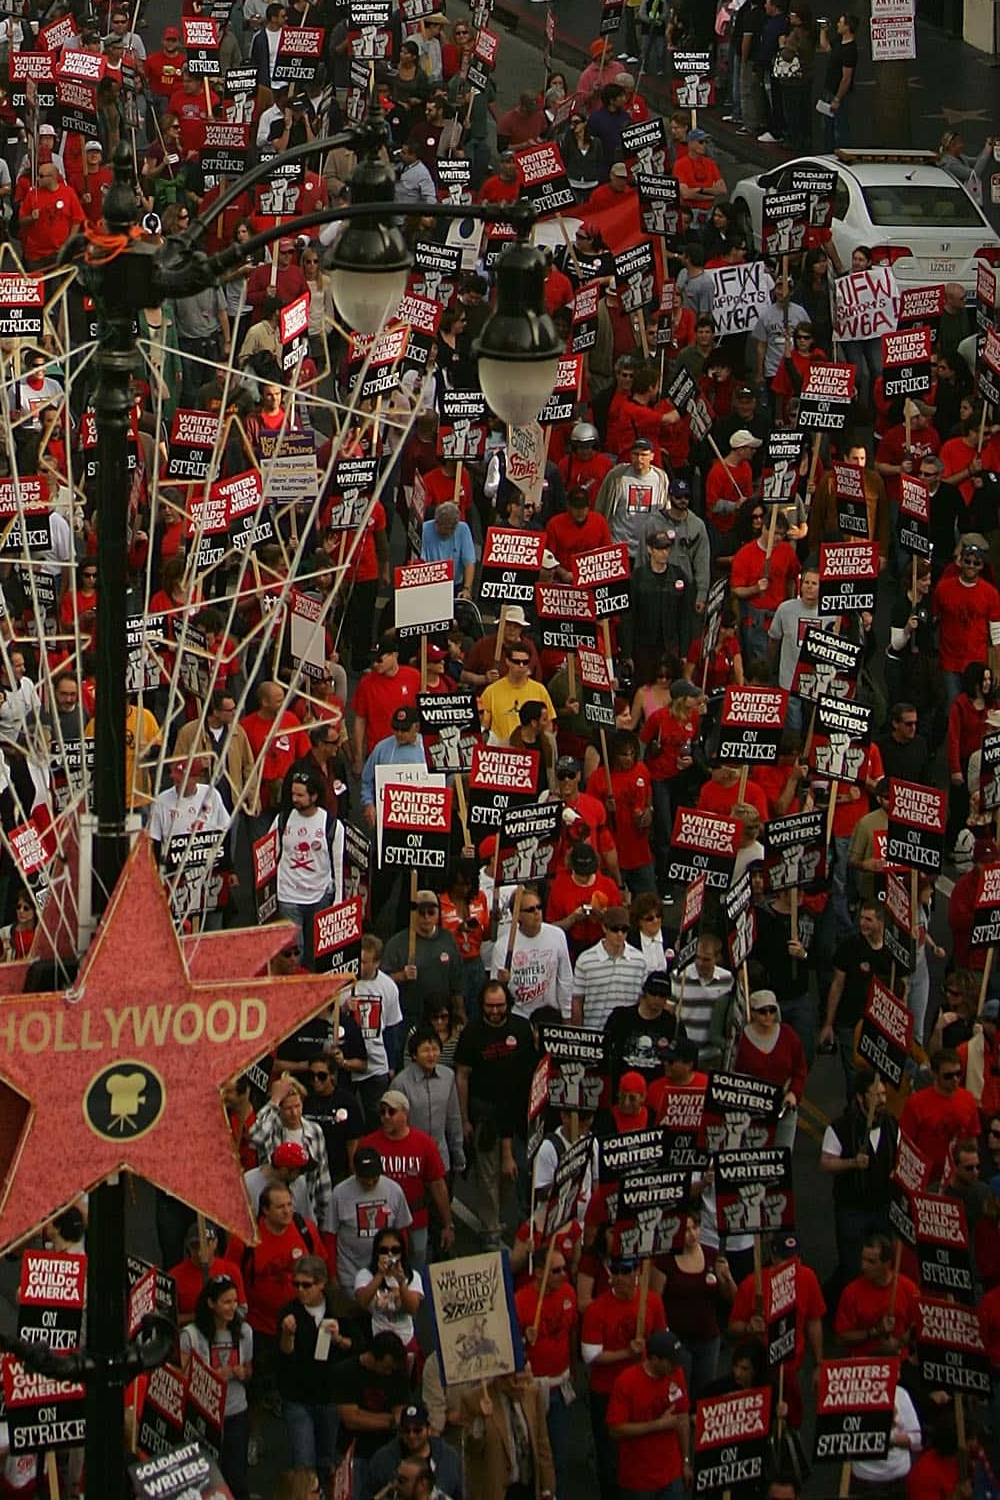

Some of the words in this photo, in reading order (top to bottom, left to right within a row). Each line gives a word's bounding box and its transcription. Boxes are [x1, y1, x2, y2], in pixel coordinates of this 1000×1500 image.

[351, 4, 389, 12] SOLIDARITY
[351, 13, 389, 21] WRITERS
[873, 29, 886, 38] NO
[876, 39, 910, 48] ANYTIME
[673, 51, 710, 61] SOLIDARITY
[674, 61, 710, 71] WRITERS
[765, 192, 807, 206] SOLIDARITY
[766, 203, 806, 217] WRITERS
[838, 267, 891, 307] UFW
[885, 332, 925, 347] WRITERS
[886, 350, 928, 364] AMERICA
[901, 367, 912, 377] ON
[885, 376, 929, 397] STRIKE
[492, 533, 540, 547] WRITERS
[492, 544, 526, 554] GUILD
[824, 546, 873, 557] WRITERS
[488, 553, 538, 565] AMERICA
[827, 557, 858, 567] GUILD
[860, 557, 871, 566] OF
[502, 572, 516, 583] ON
[824, 565, 874, 577] AMERICA
[481, 582, 534, 600] STRIKE
[841, 582, 854, 593] ON
[821, 593, 874, 610] STRIKE
[420, 695, 472, 706] SOLIDARITY
[731, 692, 782, 705] WRITERS
[821, 696, 871, 717] SOLIDARITY
[422, 708, 474, 720] WRITERS
[727, 711, 781, 724] AMERICA
[819, 711, 869, 733] WRITERS
[743, 731, 757, 742] ON
[720, 742, 776, 760] STRIKE
[477, 751, 532, 767] WRITERS
[479, 762, 516, 776] GUILD
[517, 769, 530, 777] OF
[475, 772, 532, 788] AMERICA
[389, 790, 444, 804] WRITERS
[494, 795, 509, 808] ON
[391, 801, 429, 814] GUILD
[431, 807, 443, 816] OF
[387, 812, 446, 826] AMERICA
[407, 834, 423, 847] ON
[385, 846, 445, 867] STRIKE
[889, 840, 940, 867] STRIKE
[718, 1151, 784, 1164] SOLIDARITY
[720, 1164, 784, 1179] WRITERS
[28, 1258, 80, 1274] WRITERS
[29, 1273, 65, 1287] GUILD
[66, 1278, 77, 1287] OF
[437, 1271, 490, 1291] WRITERS
[25, 1286, 80, 1300] AMERICA
[456, 1283, 490, 1301] GUILD
[42, 1311, 57, 1327] ON
[827, 1365, 890, 1380] WRITERS
[828, 1379, 871, 1393] GUILD
[872, 1380, 886, 1390] OF
[824, 1392, 889, 1408] AMERICA
[38, 1407, 57, 1422] ON
[843, 1416, 861, 1432] ON
[817, 1432, 886, 1456] STRIKE
